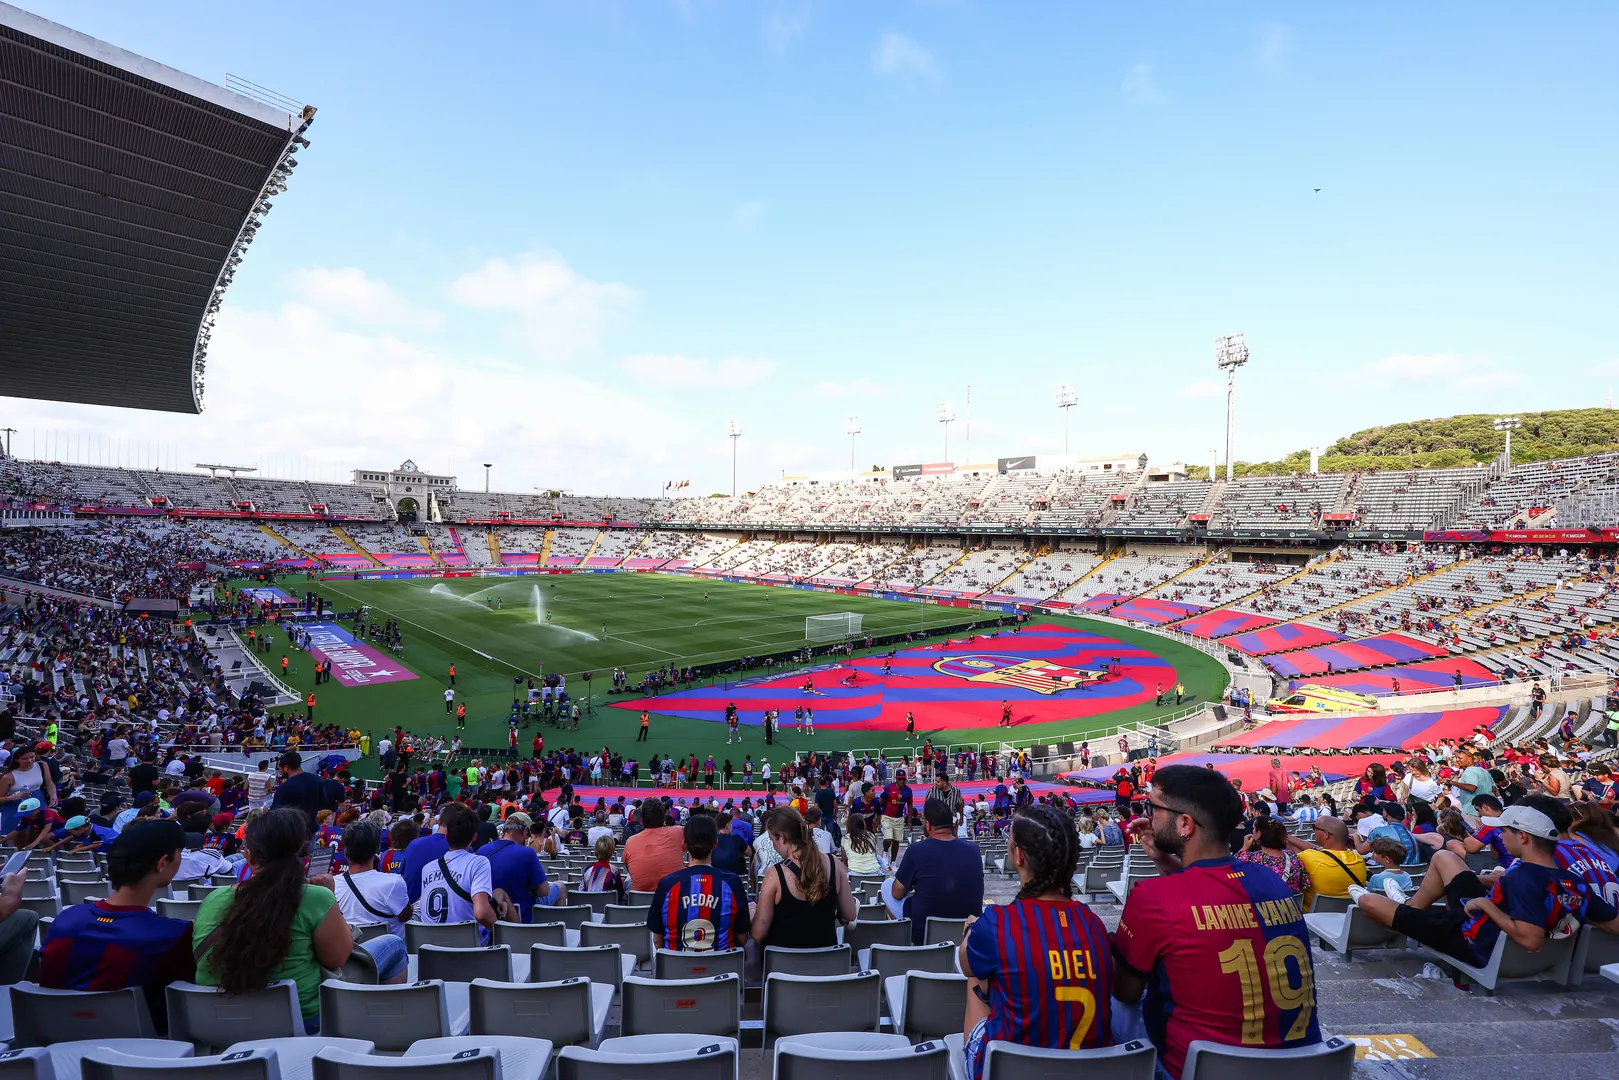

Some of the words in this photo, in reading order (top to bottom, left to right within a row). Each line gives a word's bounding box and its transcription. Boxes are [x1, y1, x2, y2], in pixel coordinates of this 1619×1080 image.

[426, 887, 448, 923] 9
[682, 894, 719, 909] PEDRI
[1191, 904, 1258, 930] LAMINE
[1048, 950, 1096, 979] BIEL
[1218, 935, 1316, 1044] 19
[1055, 986, 1096, 1050] 7
